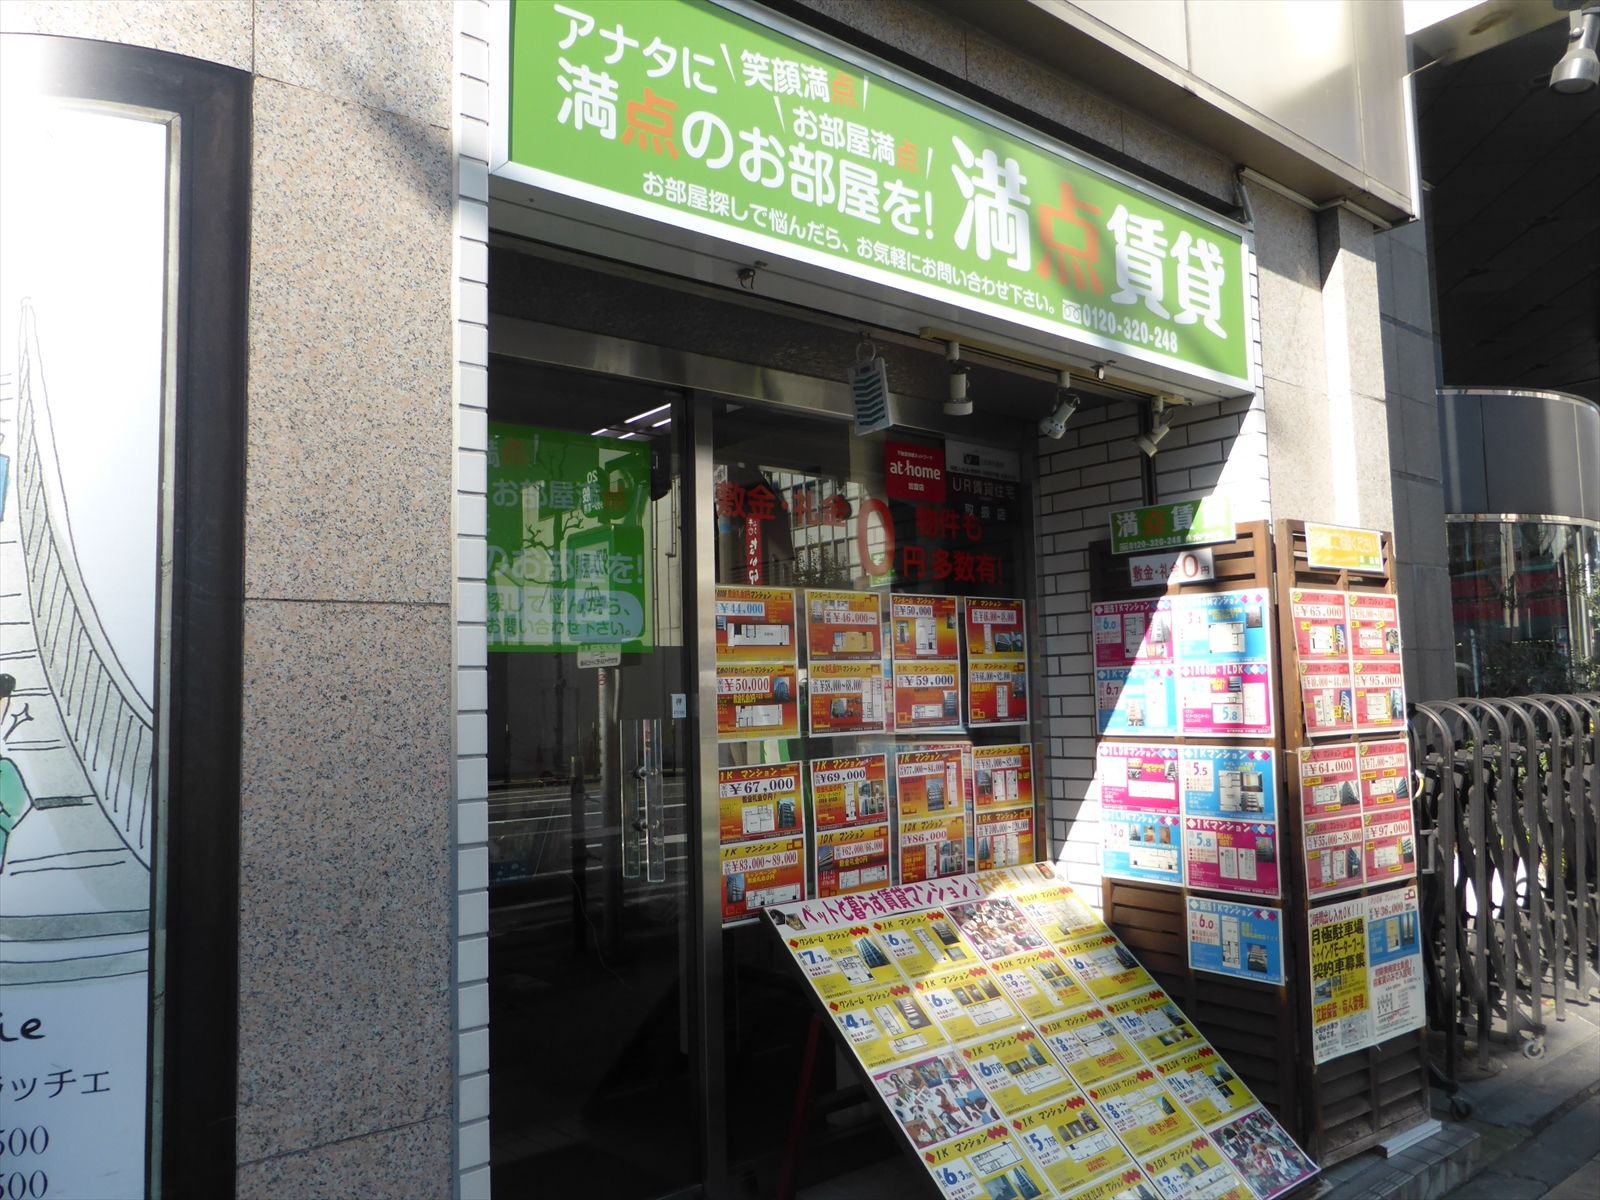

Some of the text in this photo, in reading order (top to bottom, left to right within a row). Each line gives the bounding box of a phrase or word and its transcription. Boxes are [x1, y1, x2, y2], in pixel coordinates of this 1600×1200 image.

[553, 3, 718, 94] アナタに
[740, 49, 858, 109] 笑顔満点
[557, 57, 934, 240] 満点のお部屋を!
[792, 107, 920, 173] お部屋満点
[951, 135, 1227, 340] 満点賃貸
[1083, 307, 1178, 353] 0120-320-248
[1311, 918, 1364, 946] 月極駐車場
[1312, 953, 1366, 981] 契約車募集
